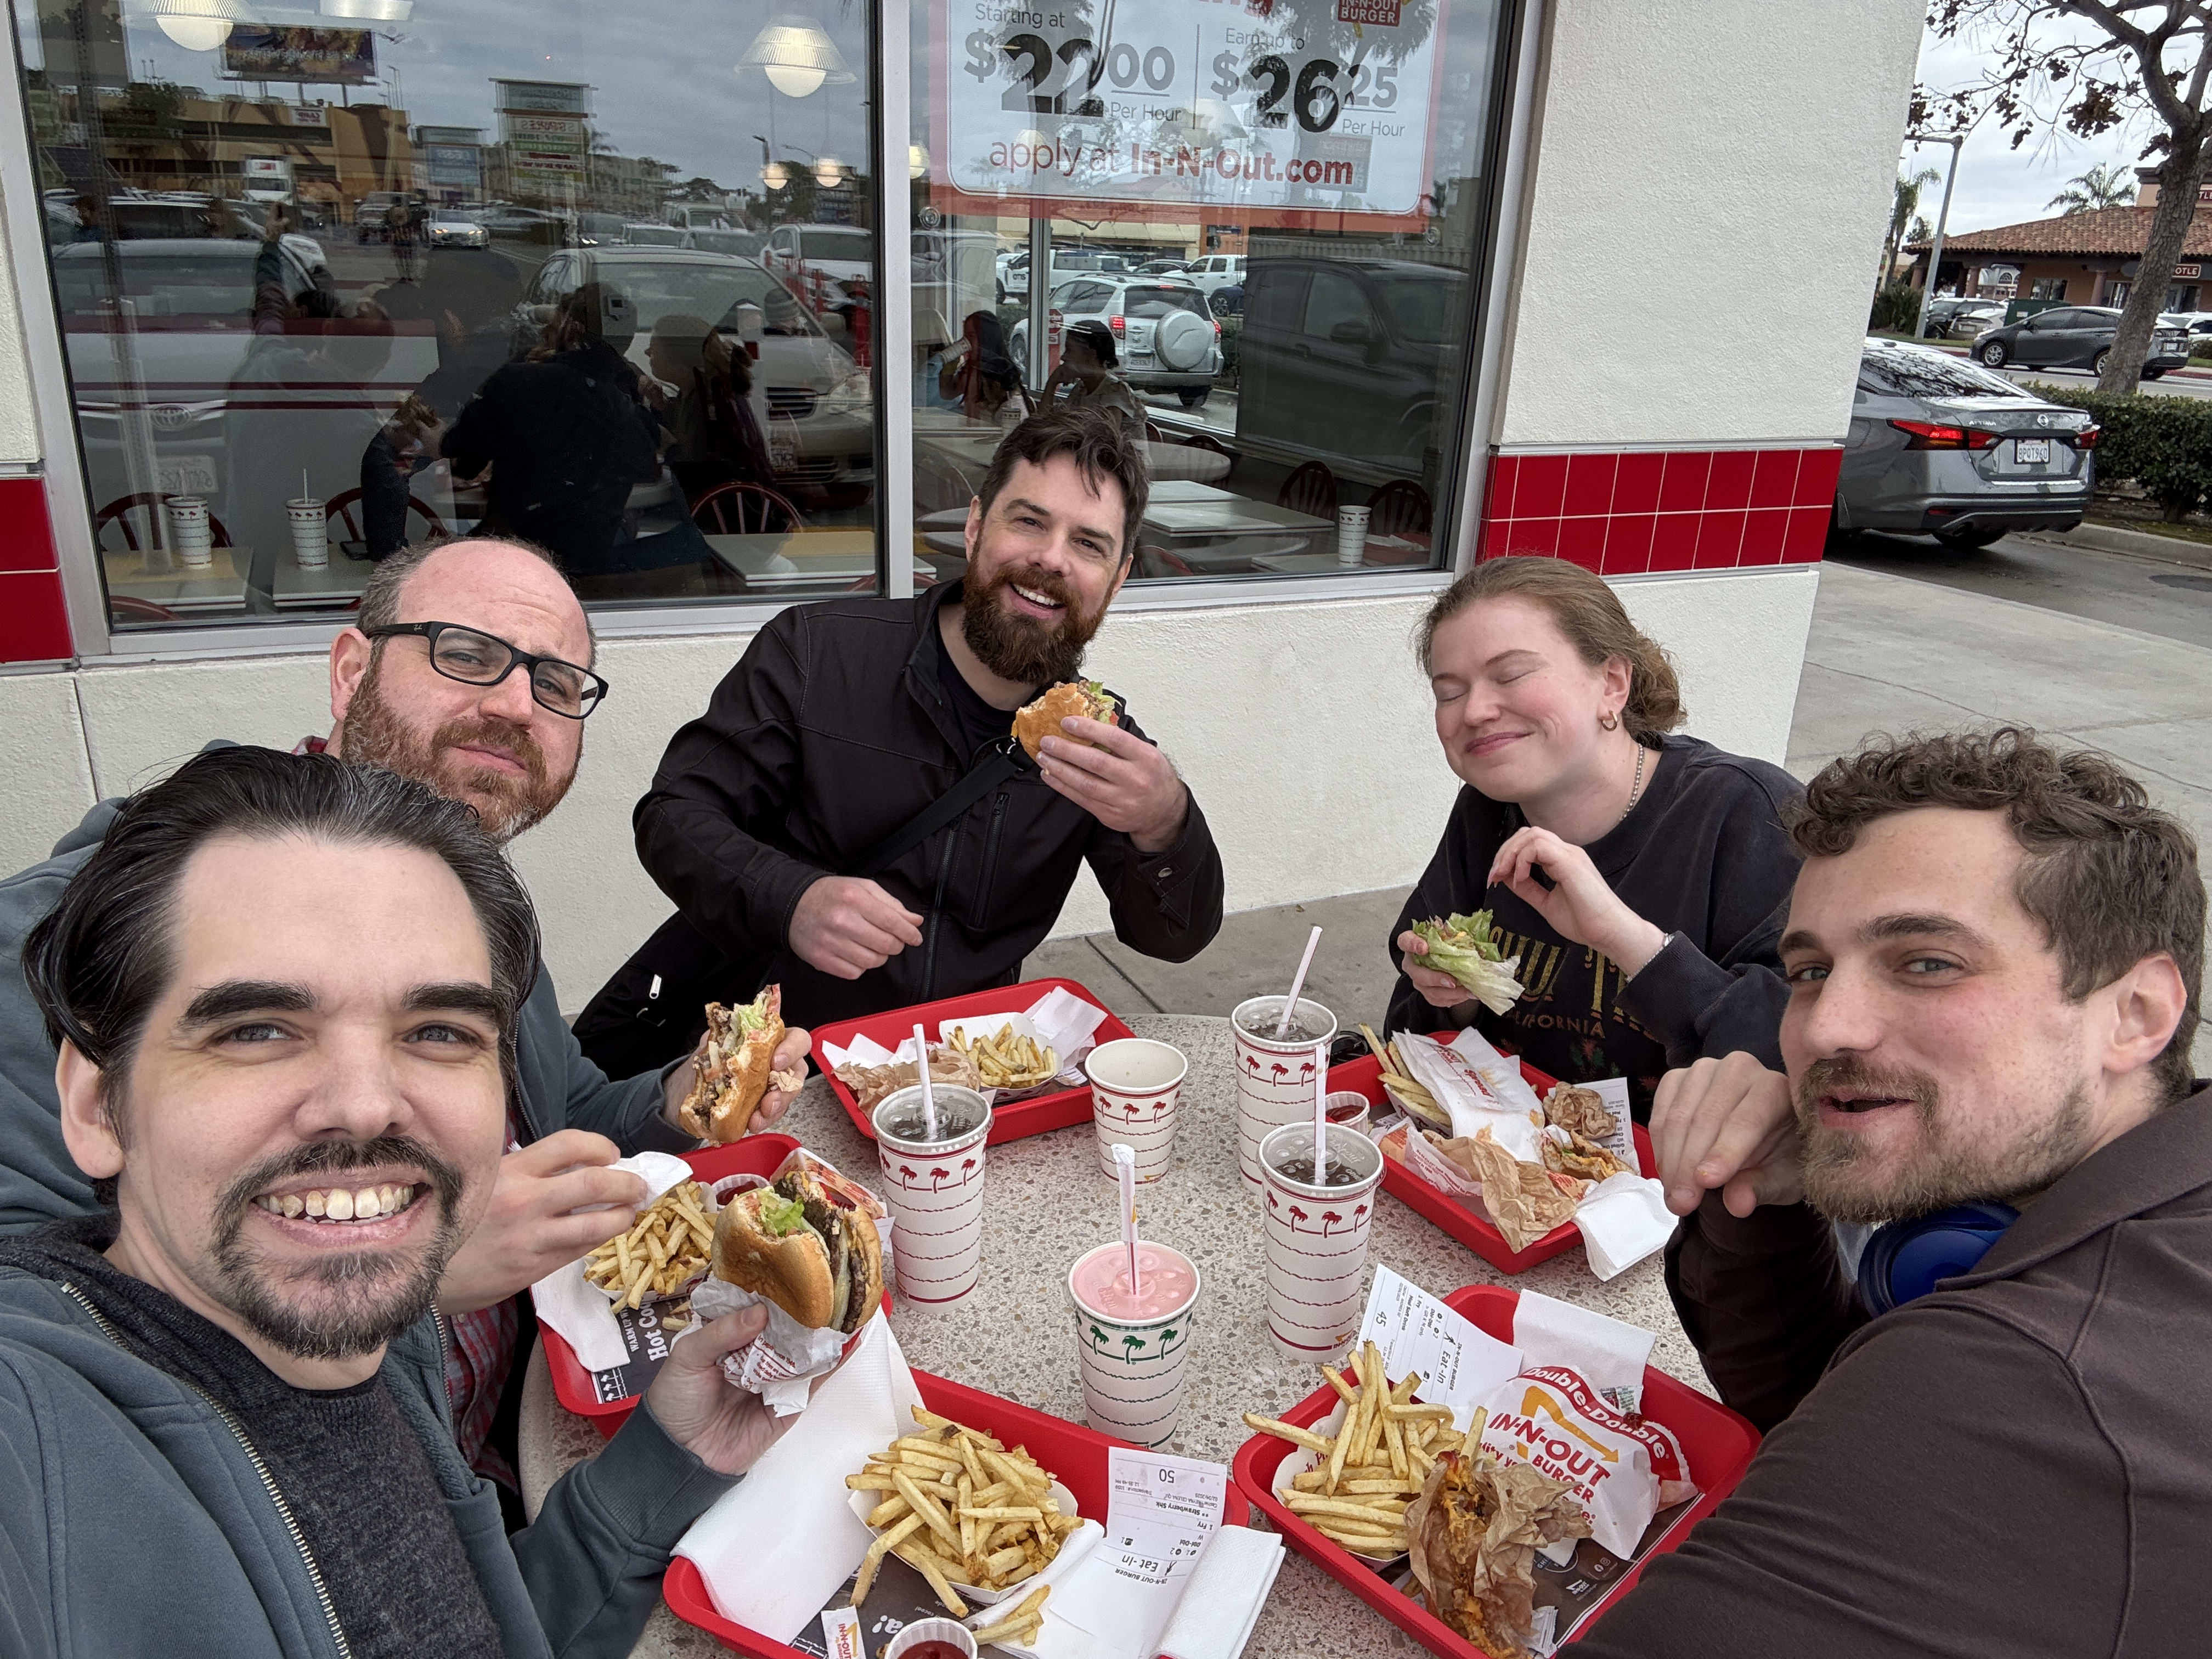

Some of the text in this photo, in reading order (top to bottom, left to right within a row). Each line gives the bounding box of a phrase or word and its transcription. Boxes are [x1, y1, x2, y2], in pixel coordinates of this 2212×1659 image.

[975, 3, 1065, 28] Starting at
[1341, 9, 1395, 24] BURGER
[1226, 27, 1305, 49] Earn up to
[1110, 101, 1181, 121] Per Hour
[1342, 119, 1405, 137] Per Hour
[990, 137, 1082, 176] apply
[1090, 143, 1119, 172] at
[1131, 143, 1353, 185] In-N-Out.com
[1376, 1311, 1387, 1327] 45
[625, 1325, 640, 1353] WARM
[639, 1302, 670, 1362] Hot Coc
[1441, 1351, 1451, 1369] Eat
[1449, 1343, 1463, 1391] IN-N-OUT BURGER
[1488, 1412, 1611, 1487] IN-N-OUT
[1159, 1468, 1176, 1483] 50
[1167, 1503, 1201, 1515] Strawberry
[1197, 1521, 1207, 1530] Fry
[1180, 1539, 1201, 1547] Dbl-Dbl
[1115, 1567, 1141, 1581] BURGER
[1139, 1559, 1159, 1572] Eat
[838, 1623, 851, 1659] IN-N-OUT
